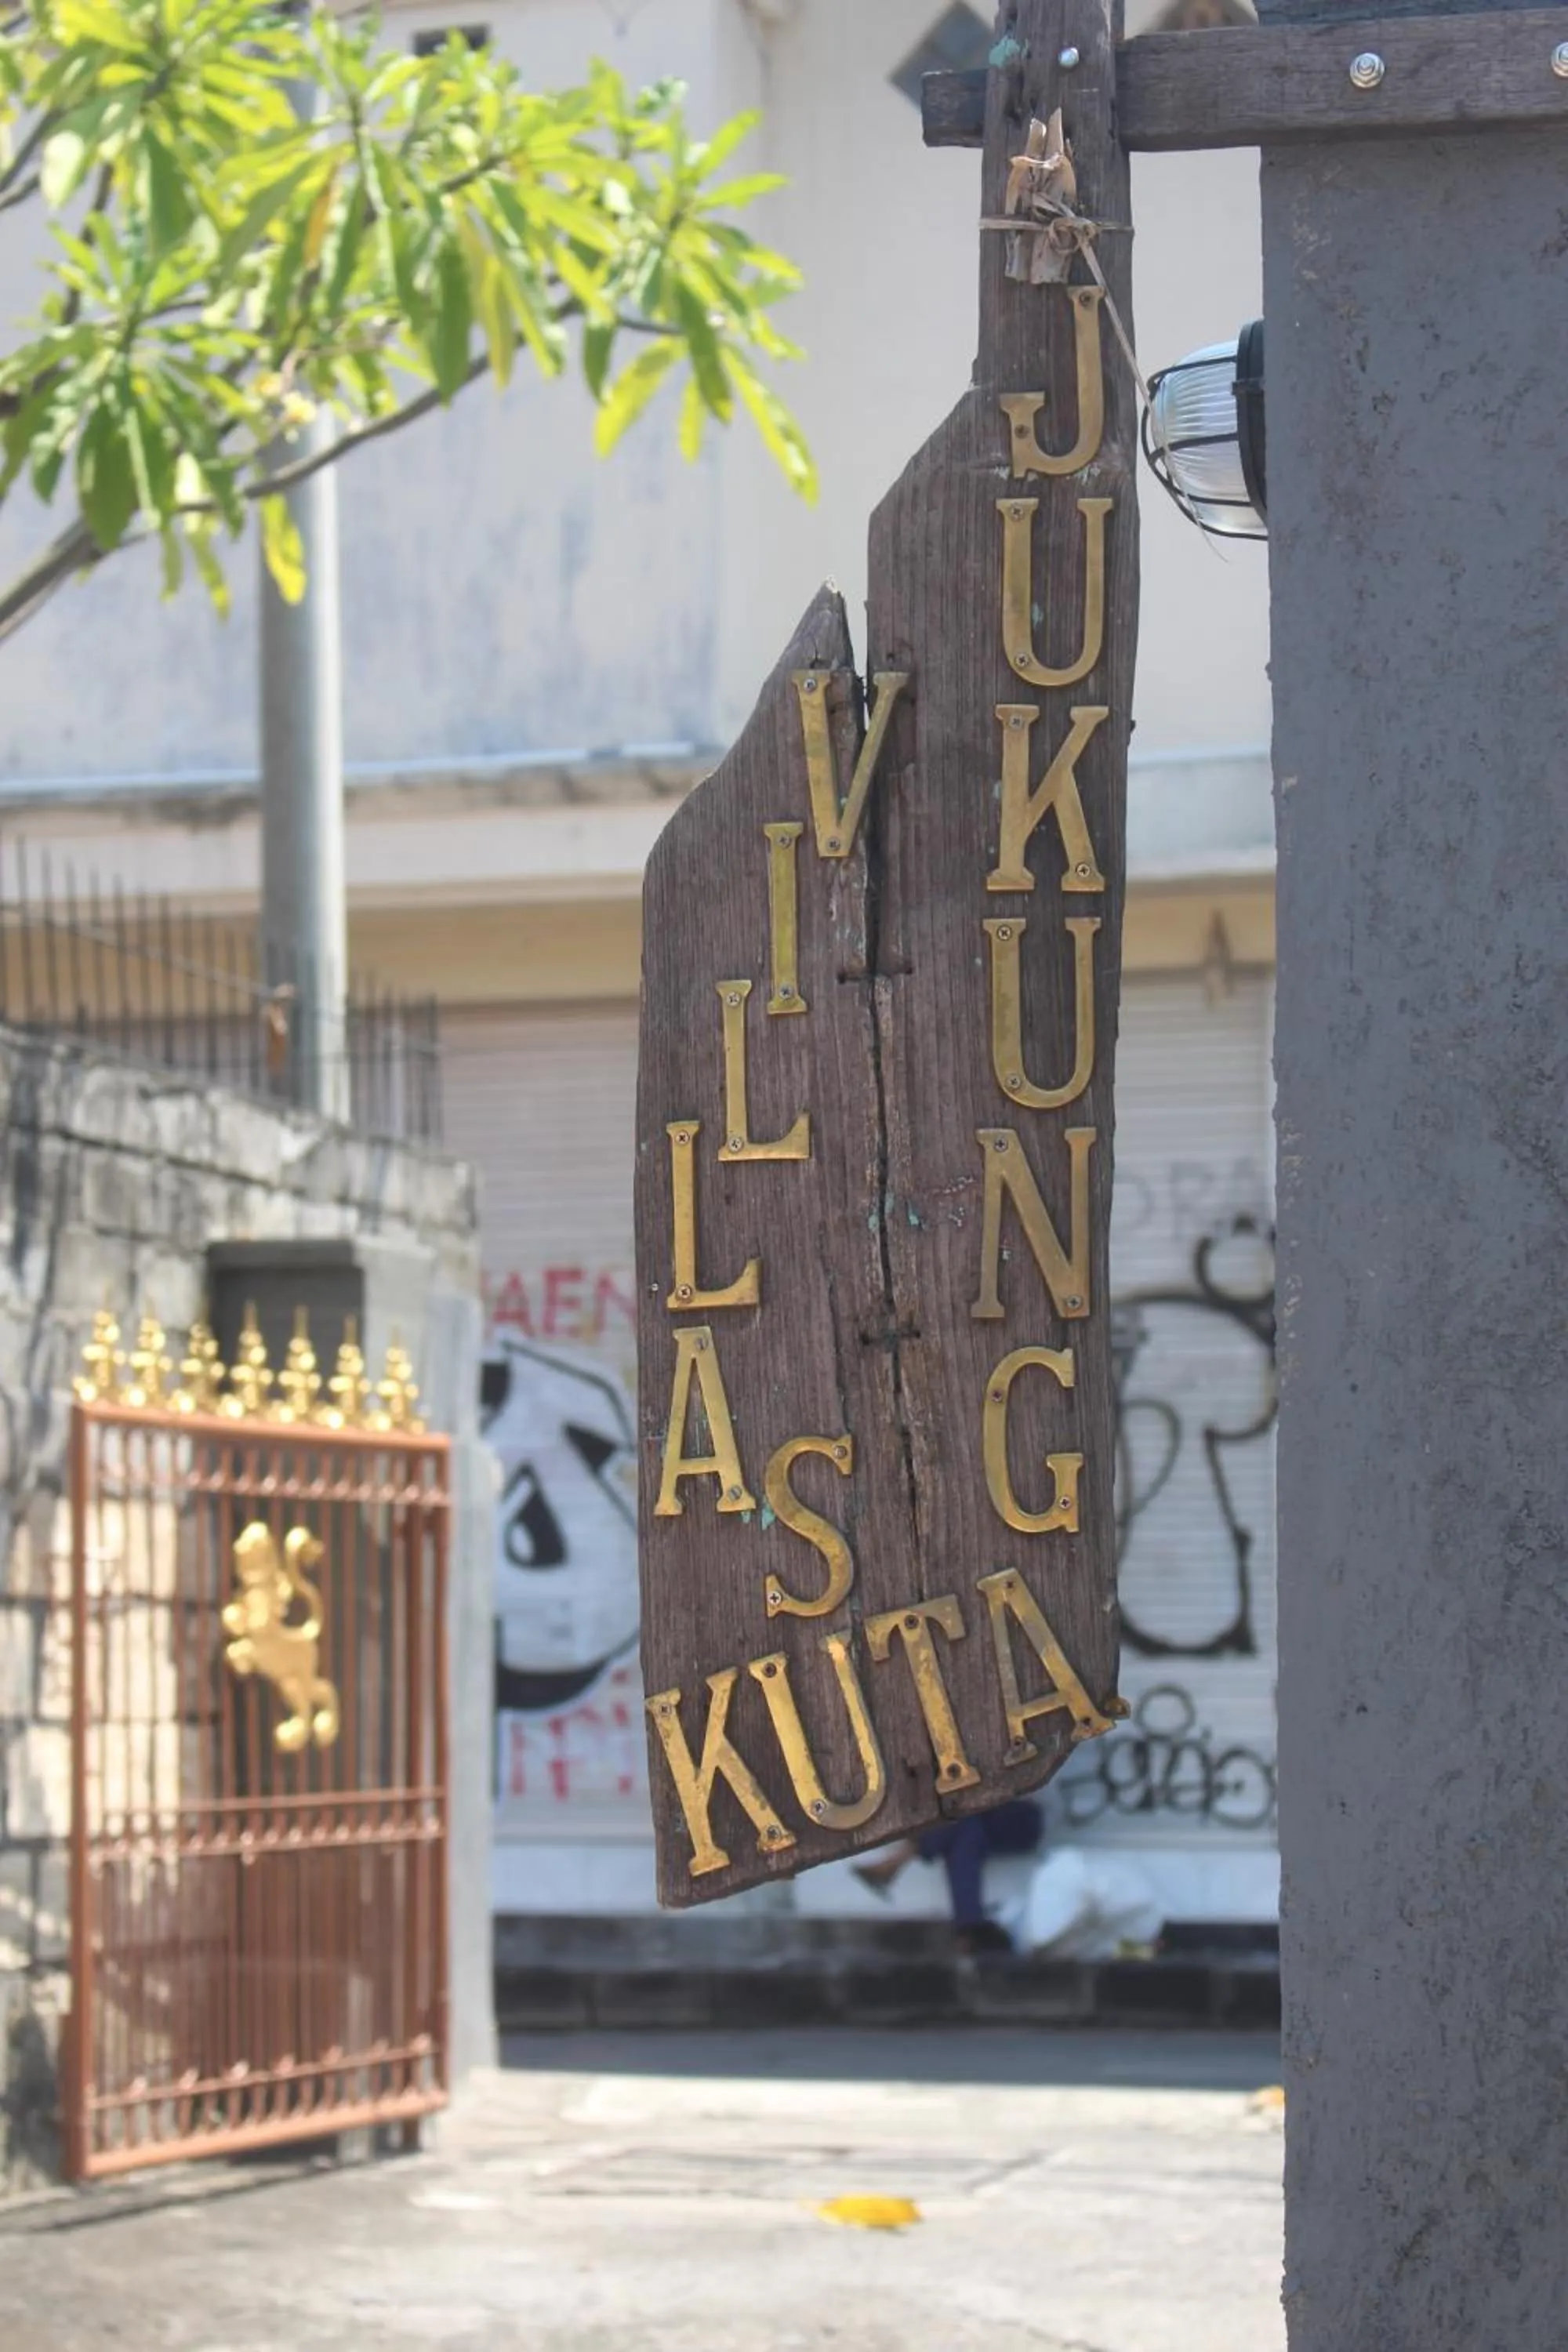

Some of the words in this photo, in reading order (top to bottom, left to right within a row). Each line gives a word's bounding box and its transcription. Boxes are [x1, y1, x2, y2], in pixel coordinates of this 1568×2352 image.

[653, 669, 912, 1618] VILLAS
[970, 284, 1113, 1534] JUKUNG
[644, 1568, 1116, 1877] KUTA
